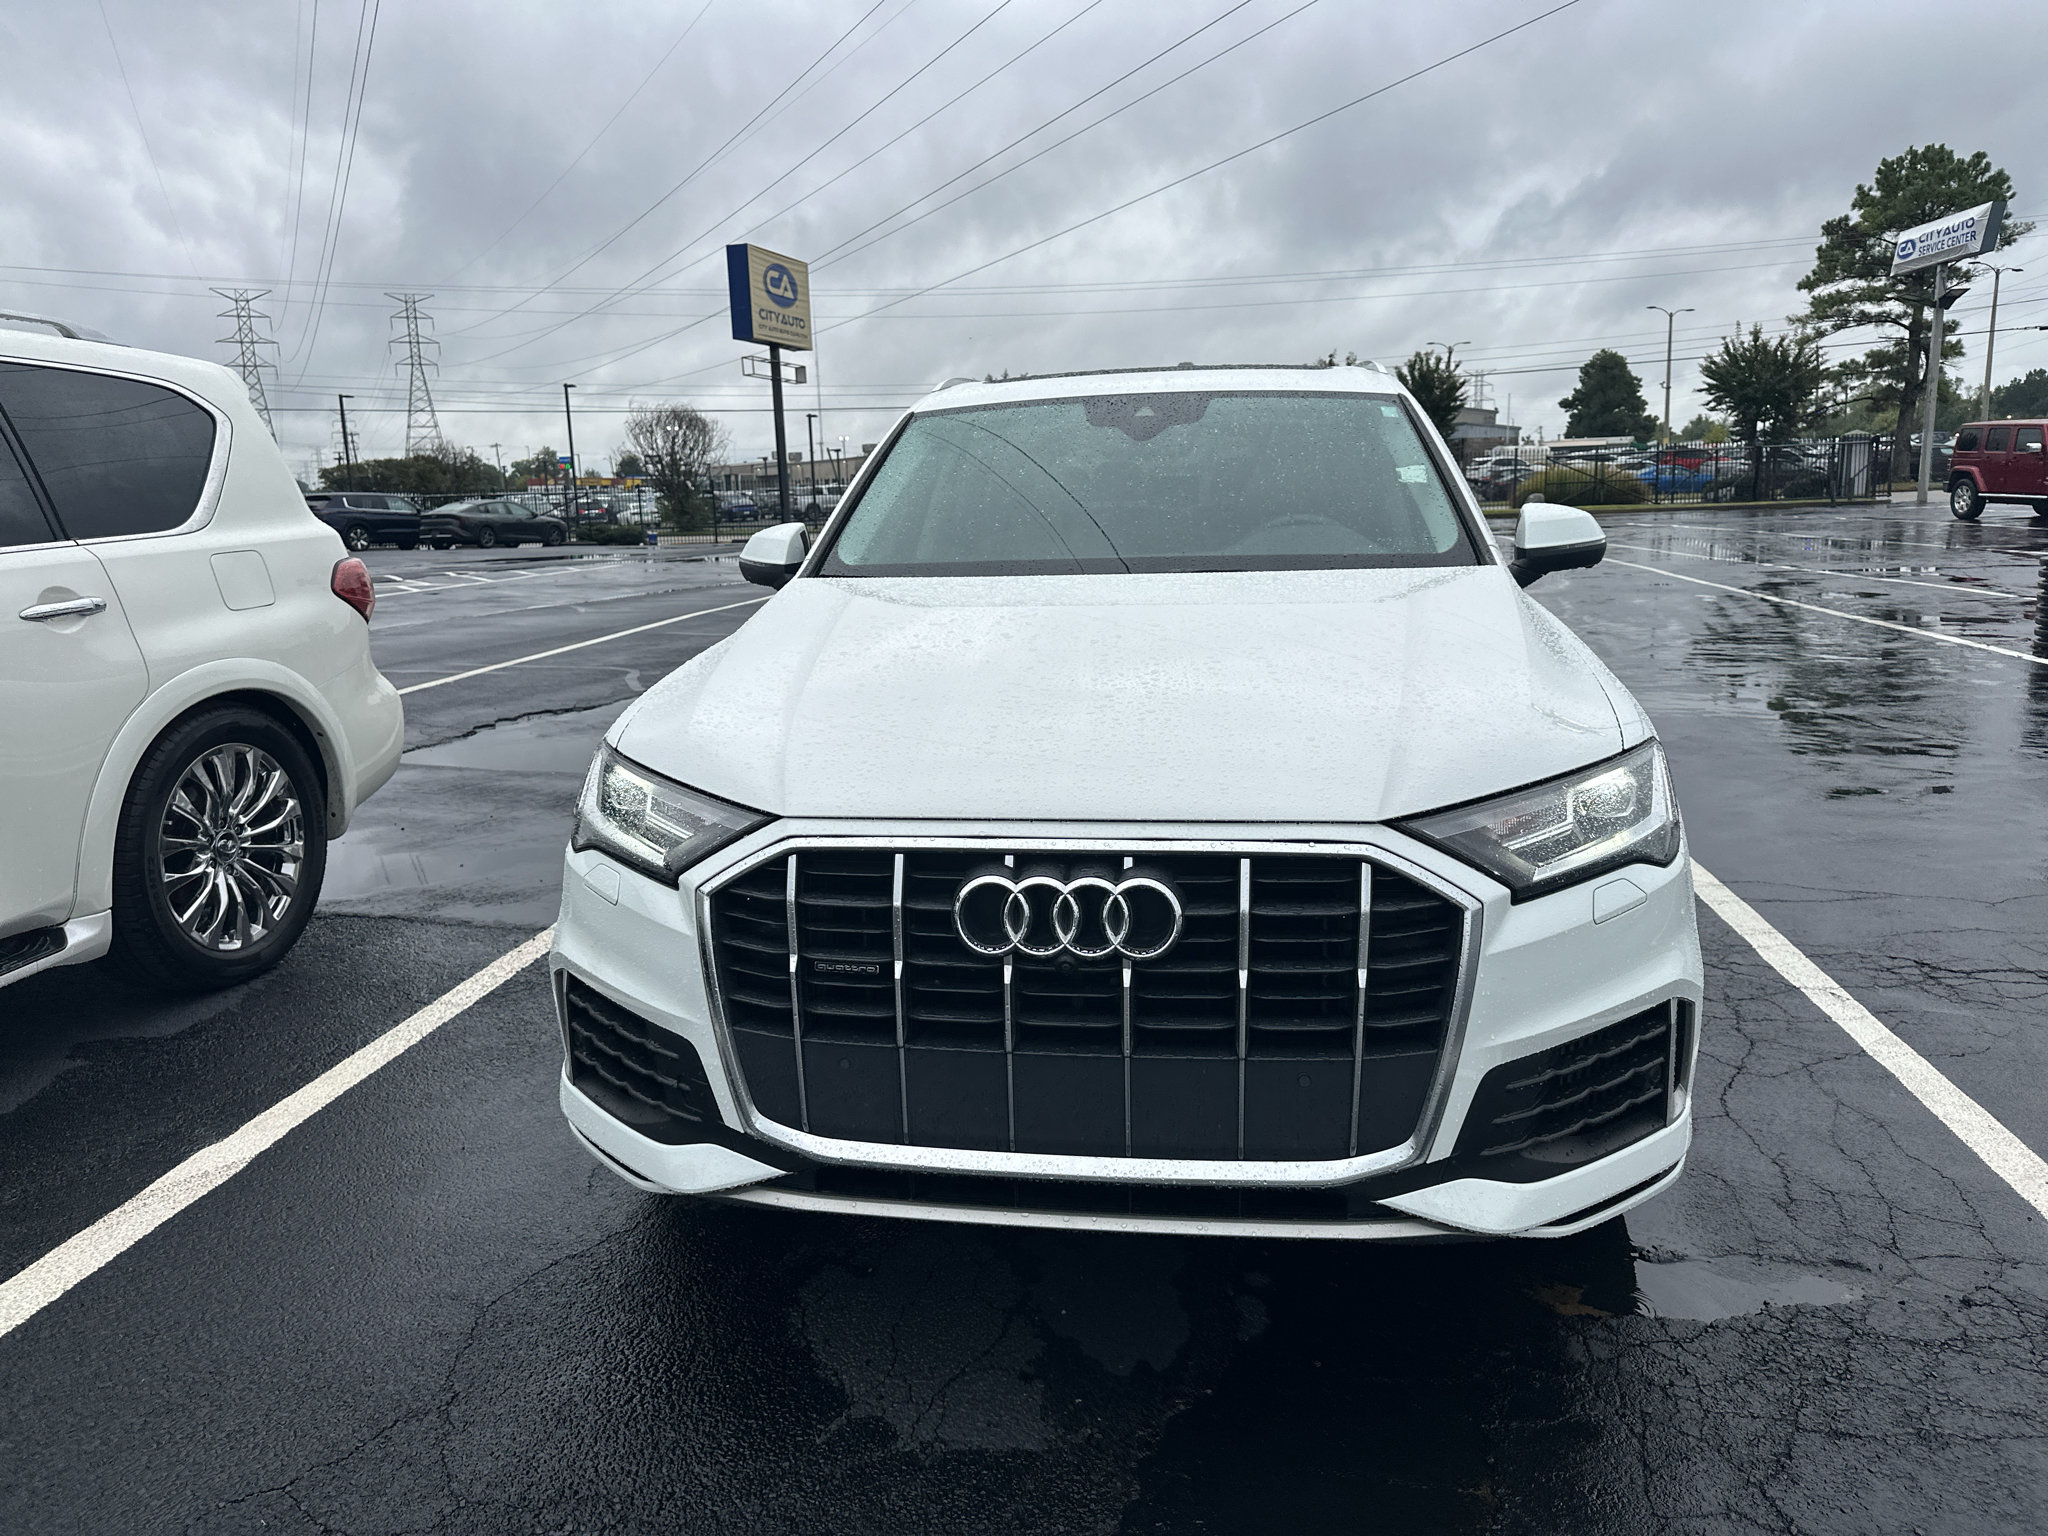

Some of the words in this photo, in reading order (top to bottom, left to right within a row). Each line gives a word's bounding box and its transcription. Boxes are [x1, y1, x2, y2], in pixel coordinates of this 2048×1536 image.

[1918, 241, 1945, 256] SERVICE
[1946, 230, 1977, 247] CENTER
[766, 269, 796, 300] CA
[817, 963, 876, 973] quattro
